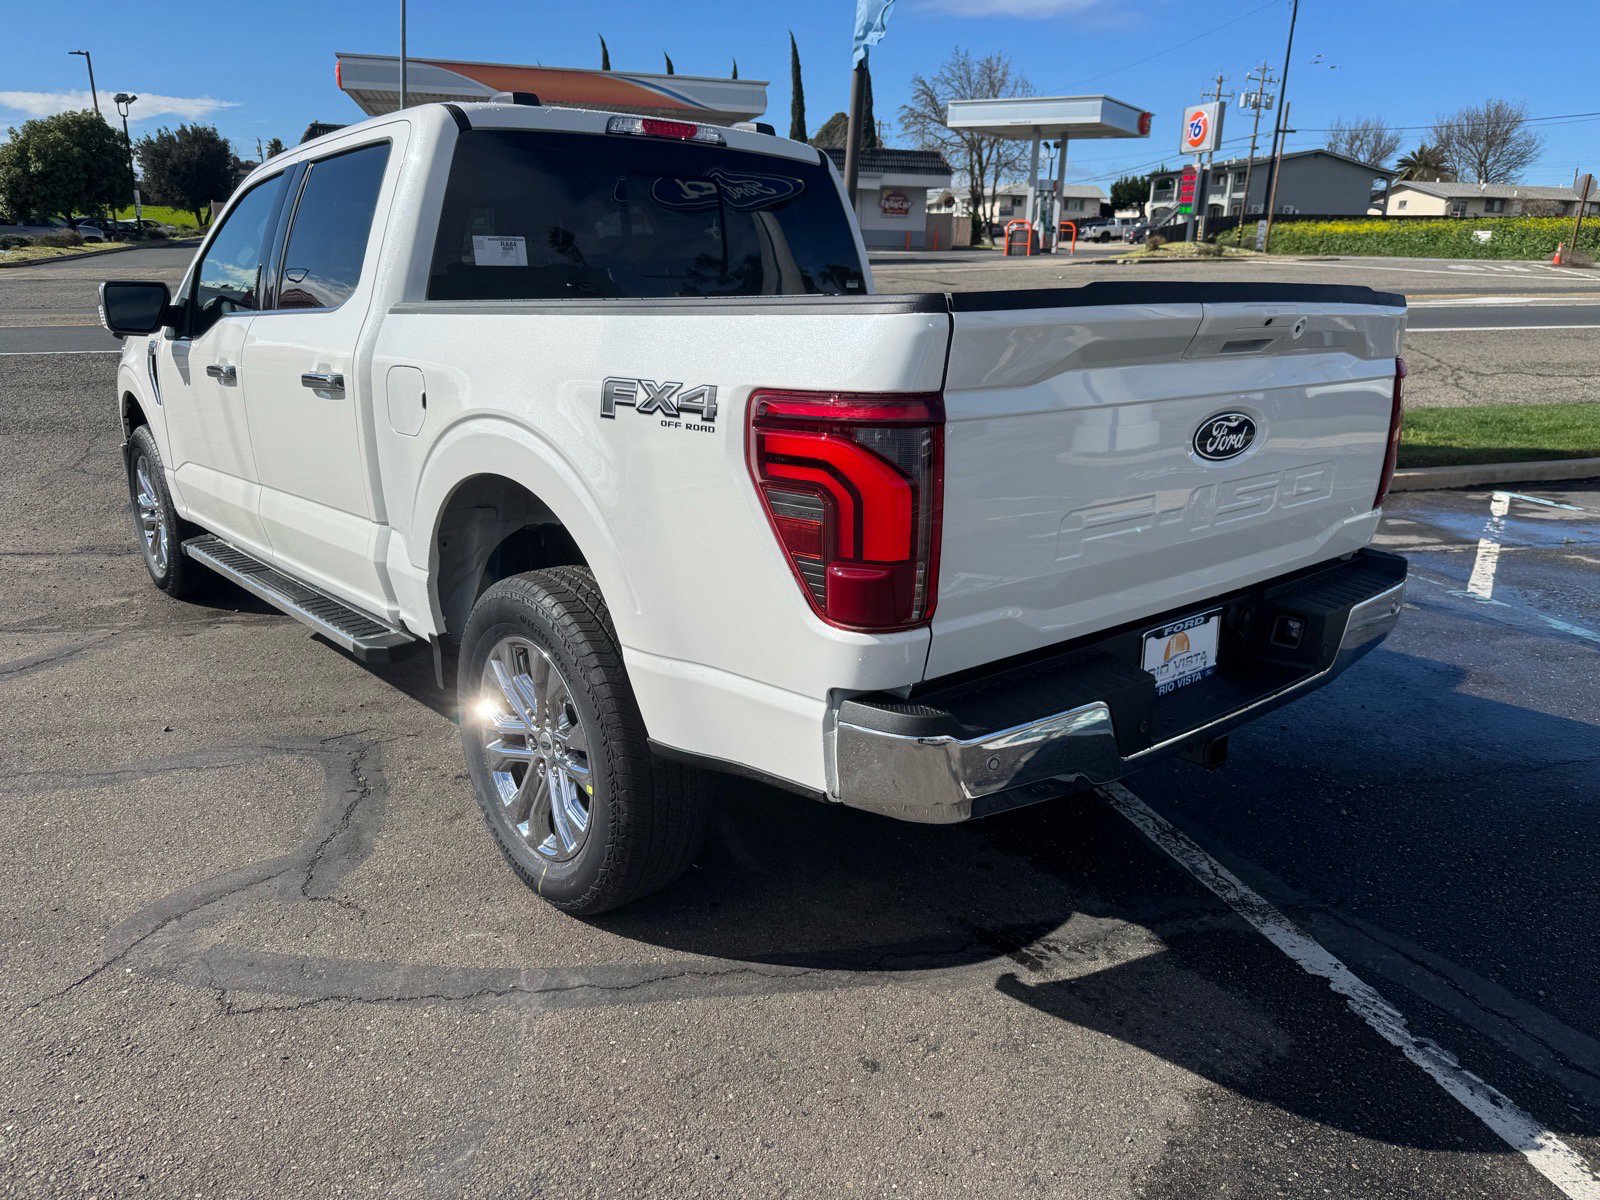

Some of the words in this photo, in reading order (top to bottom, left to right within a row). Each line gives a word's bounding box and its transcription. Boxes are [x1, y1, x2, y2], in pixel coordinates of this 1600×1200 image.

[1187, 117, 1203, 140] 76
[600, 376, 718, 422] FX4
[660, 419, 682, 429] OFF
[685, 423, 716, 433] ROAD
[1055, 460, 1337, 562] F-150
[1163, 616, 1205, 637] FORD
[1173, 650, 1207, 670] VISTA
[1158, 682, 1175, 696] RIO
[1177, 672, 1202, 688] VISTA
